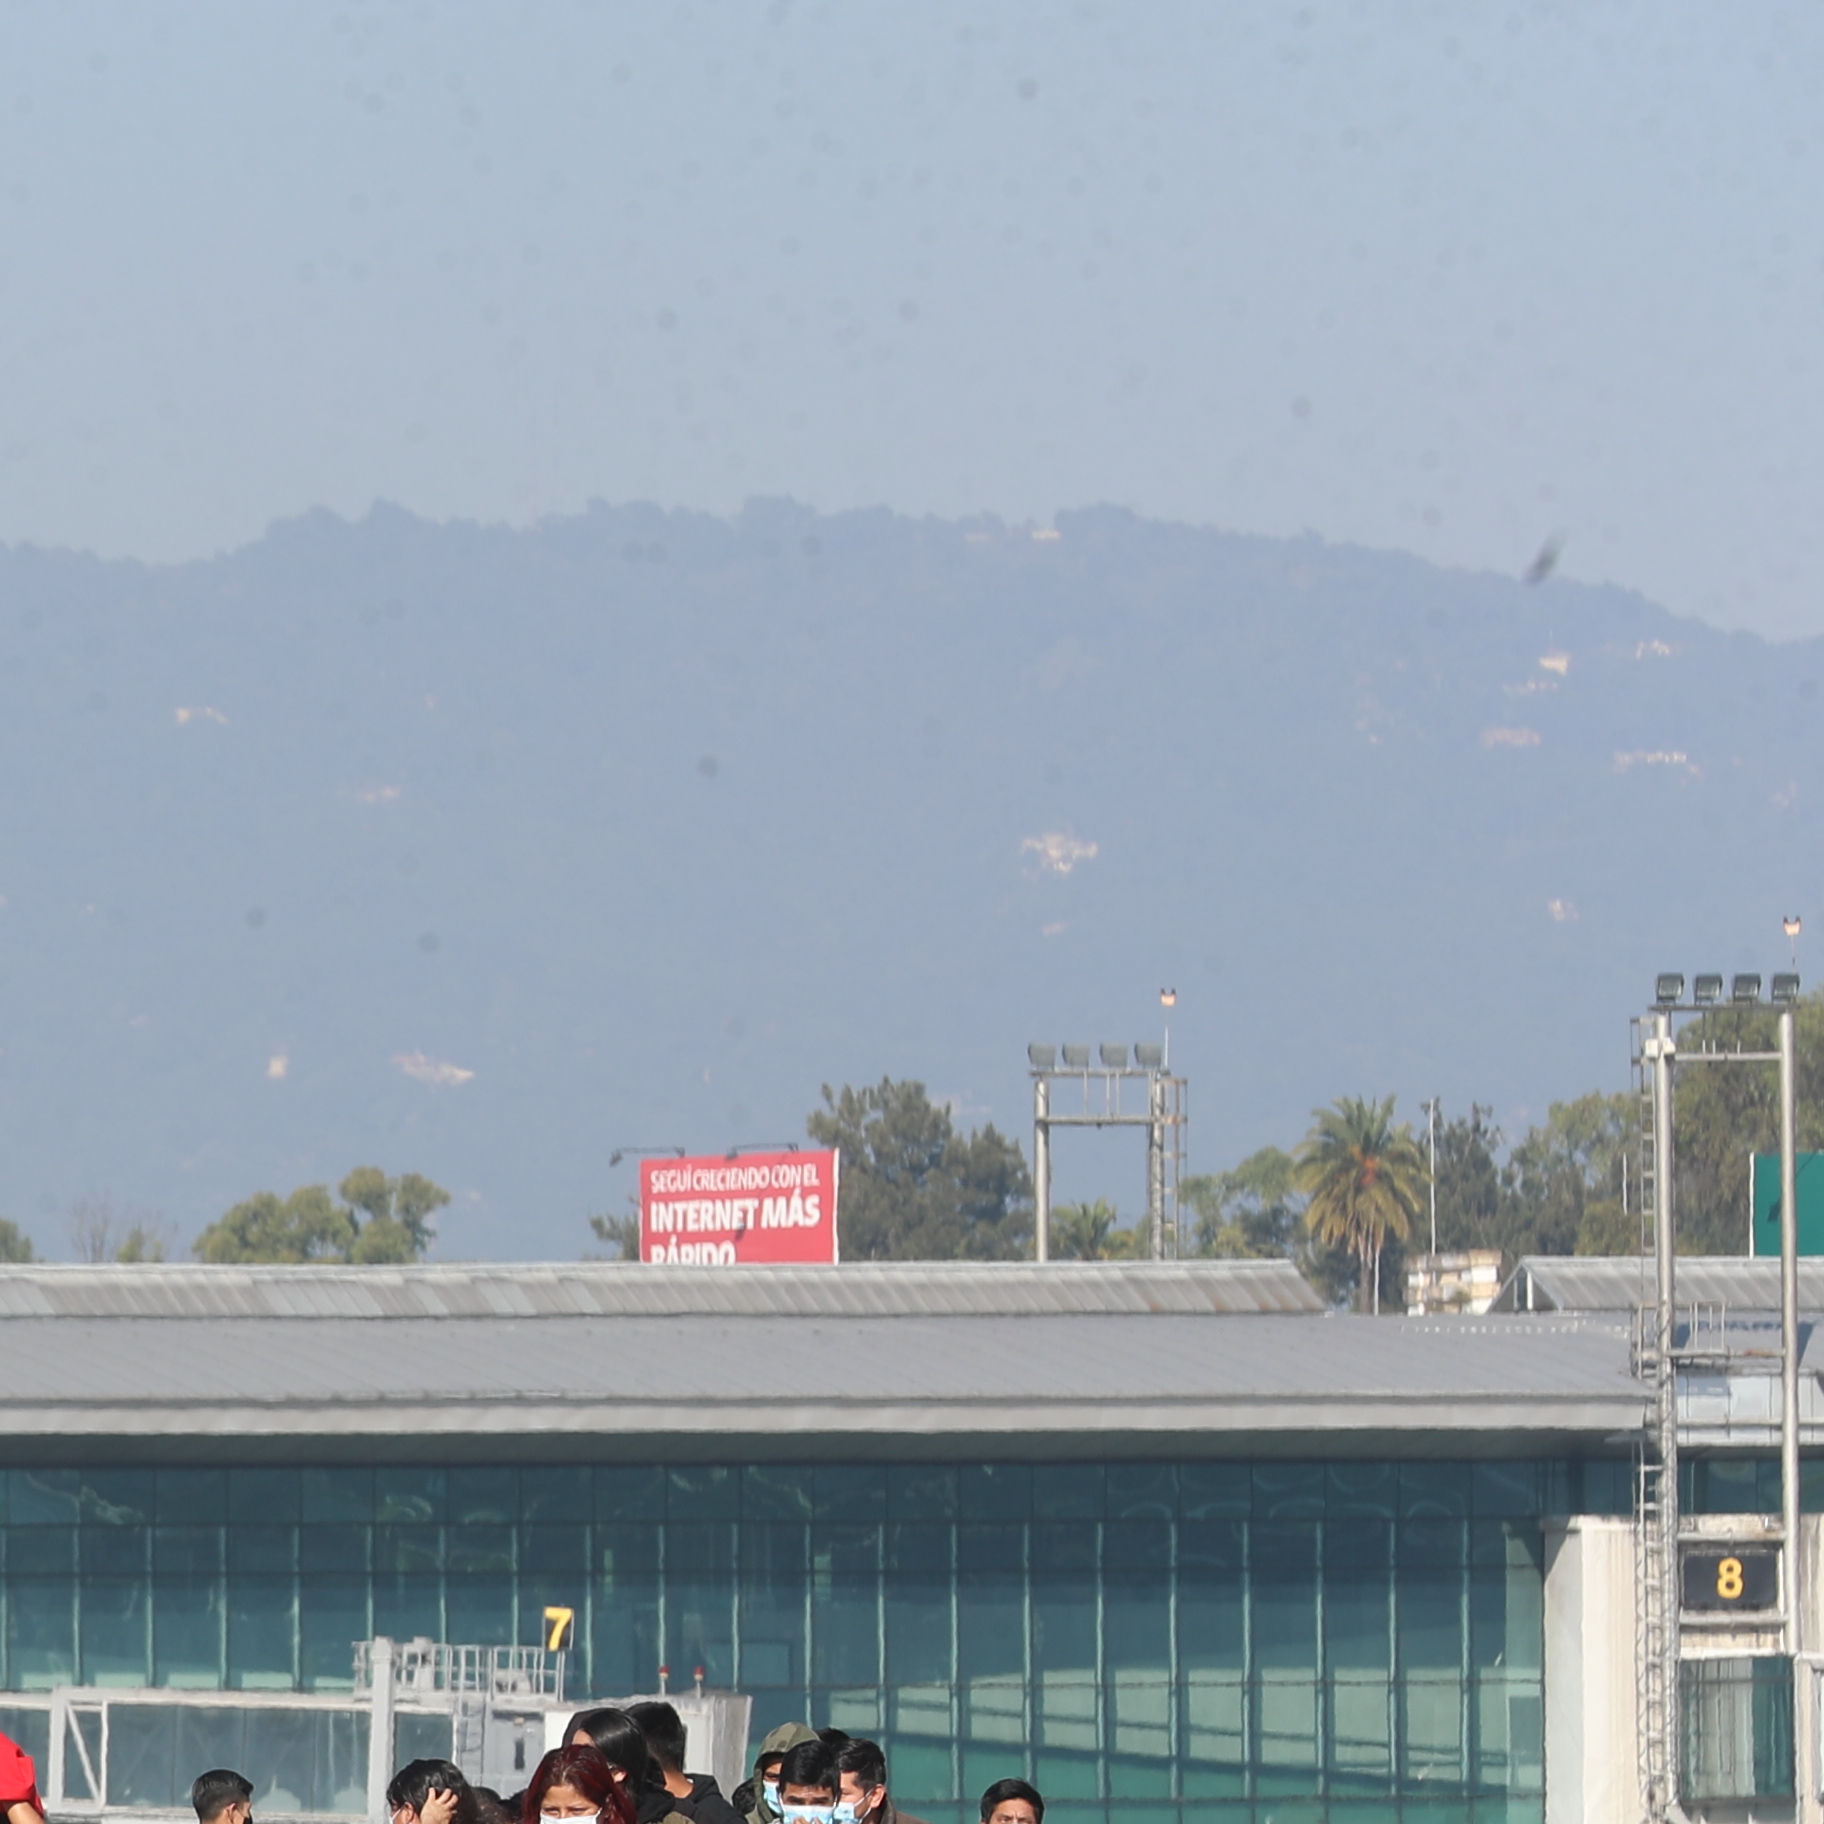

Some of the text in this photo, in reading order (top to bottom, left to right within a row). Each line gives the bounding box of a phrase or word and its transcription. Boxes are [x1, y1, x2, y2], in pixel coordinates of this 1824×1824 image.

[650, 1163, 820, 1194] SEGUÍ CRECIENDO CON EL
[650, 1187, 821, 1233] INTERNET MÁS
[1717, 1557, 1743, 1599] 8
[544, 1606, 573, 1651] 7
